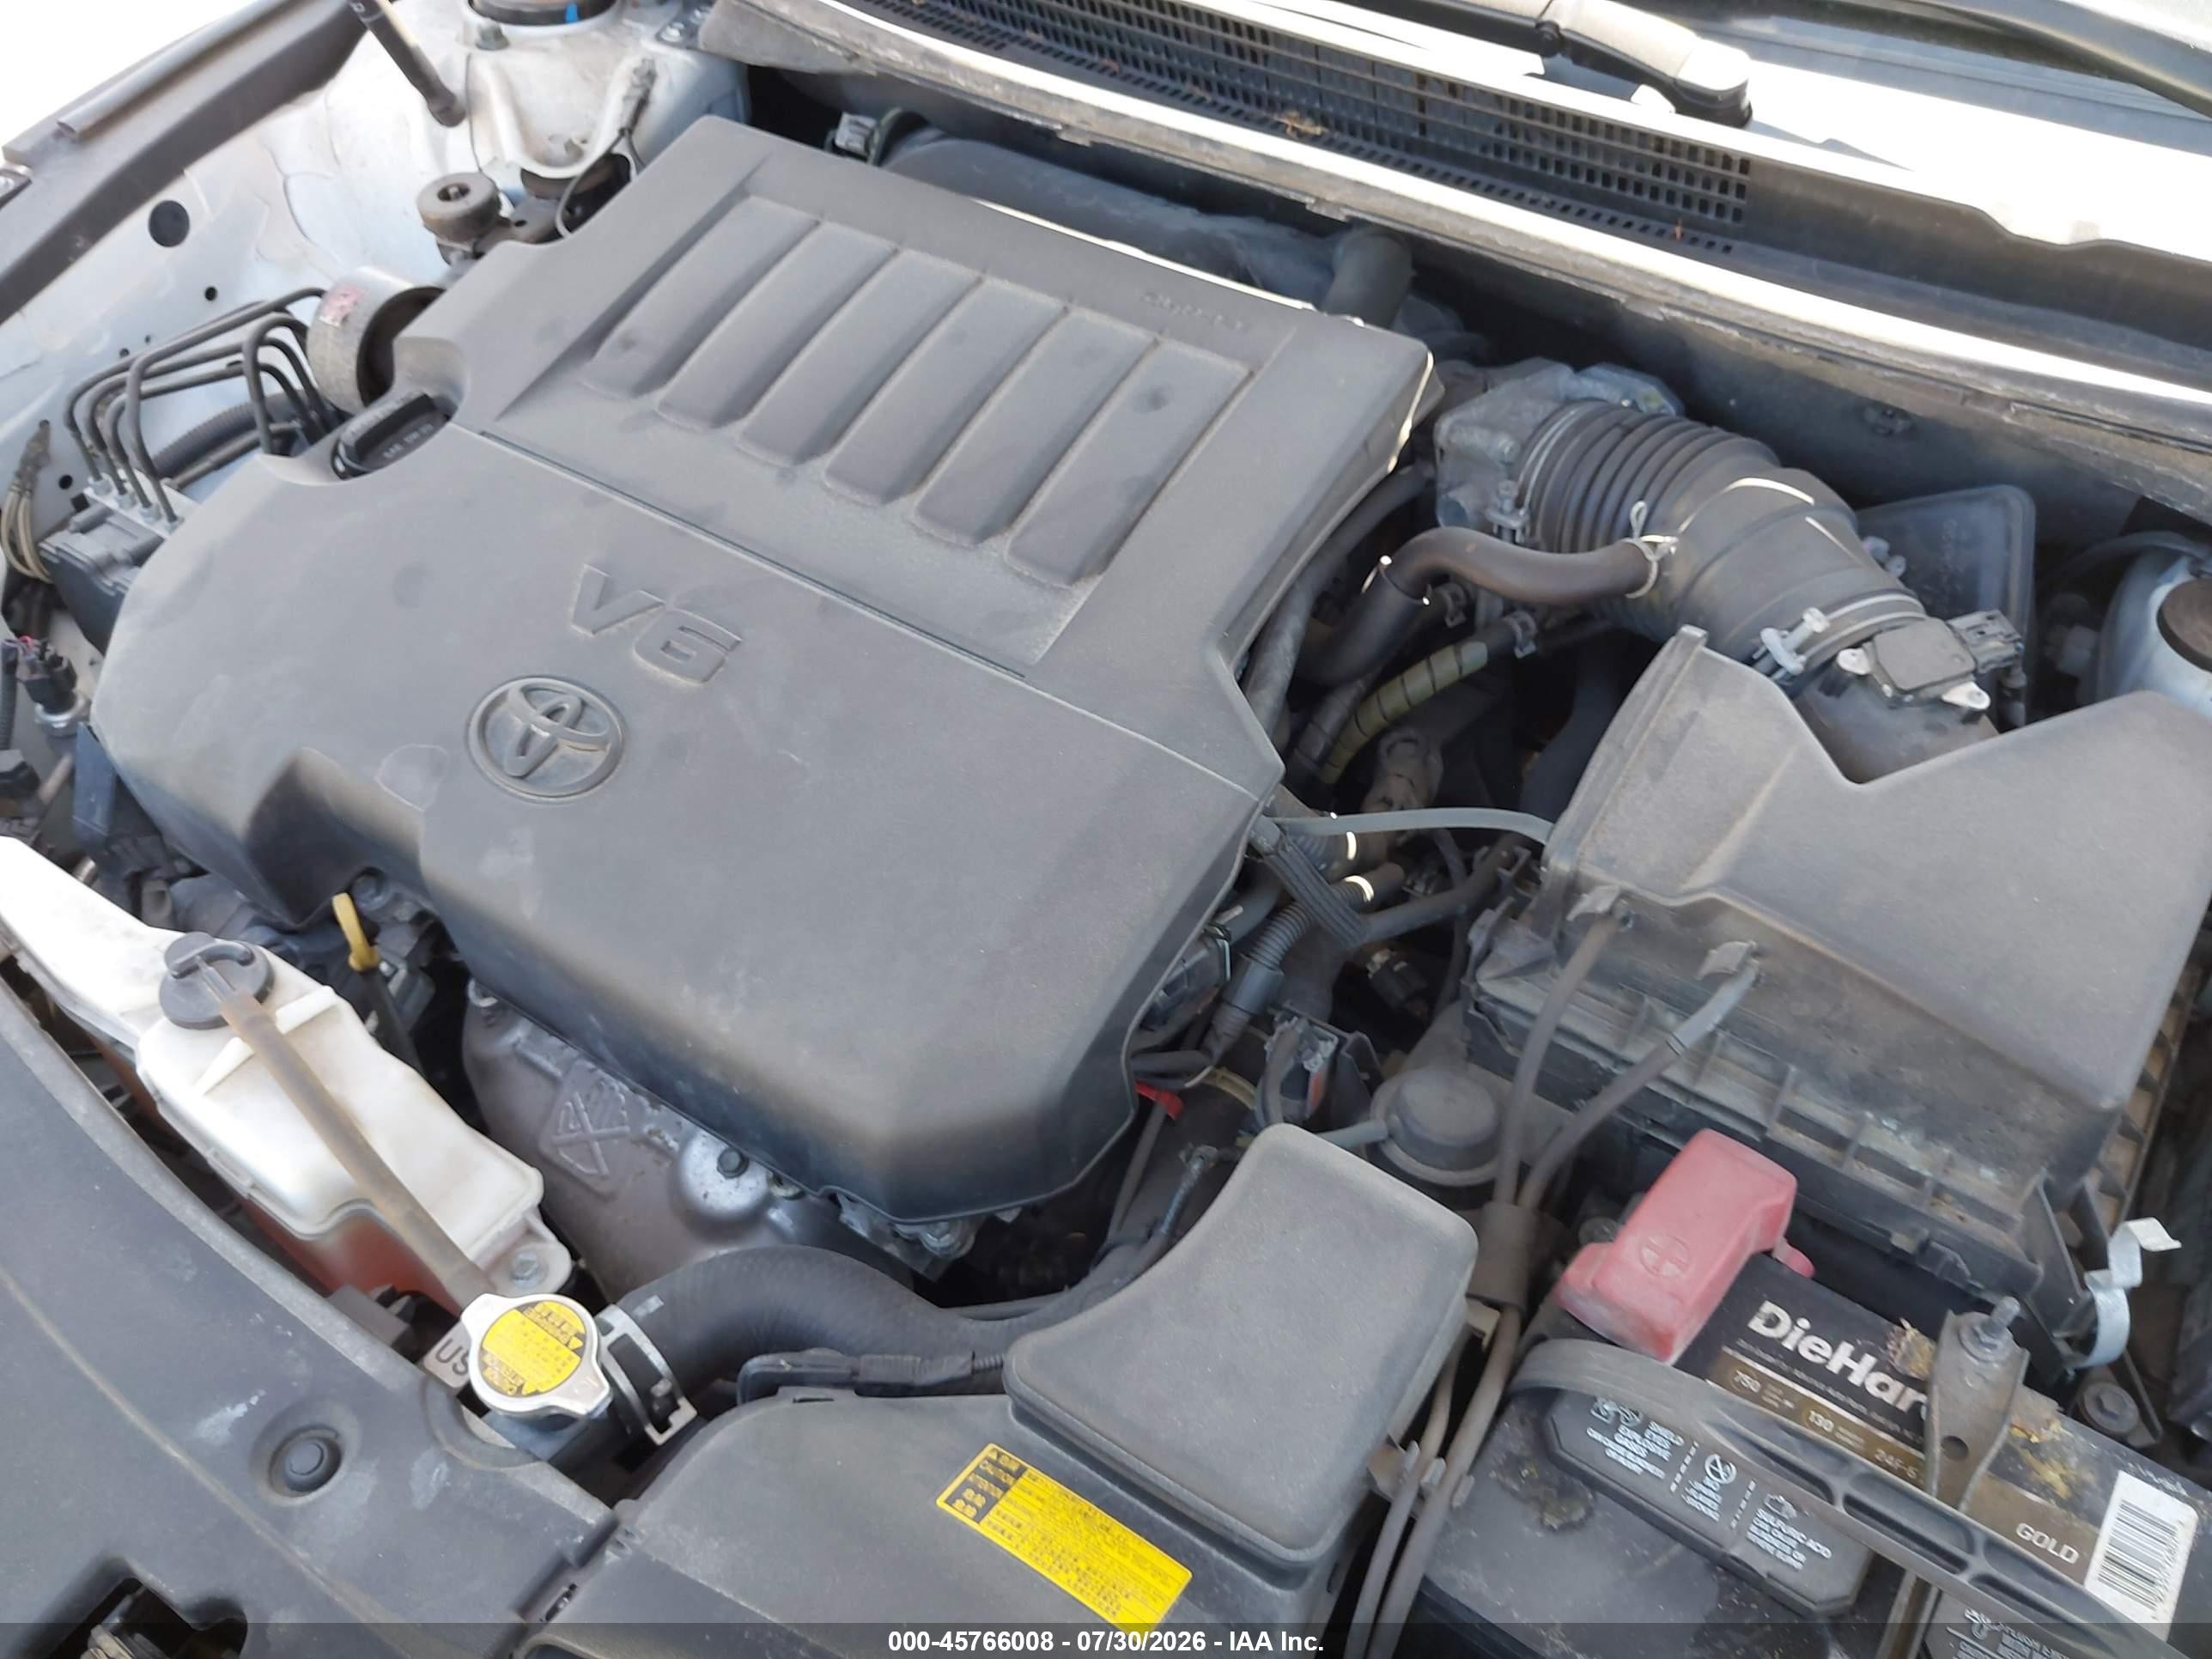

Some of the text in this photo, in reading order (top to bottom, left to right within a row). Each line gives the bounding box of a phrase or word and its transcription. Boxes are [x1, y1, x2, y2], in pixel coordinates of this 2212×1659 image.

[570, 564, 742, 684] V6
[1747, 1300, 1928, 1420] DieHar
[2015, 1522, 2080, 1565] GOLD
